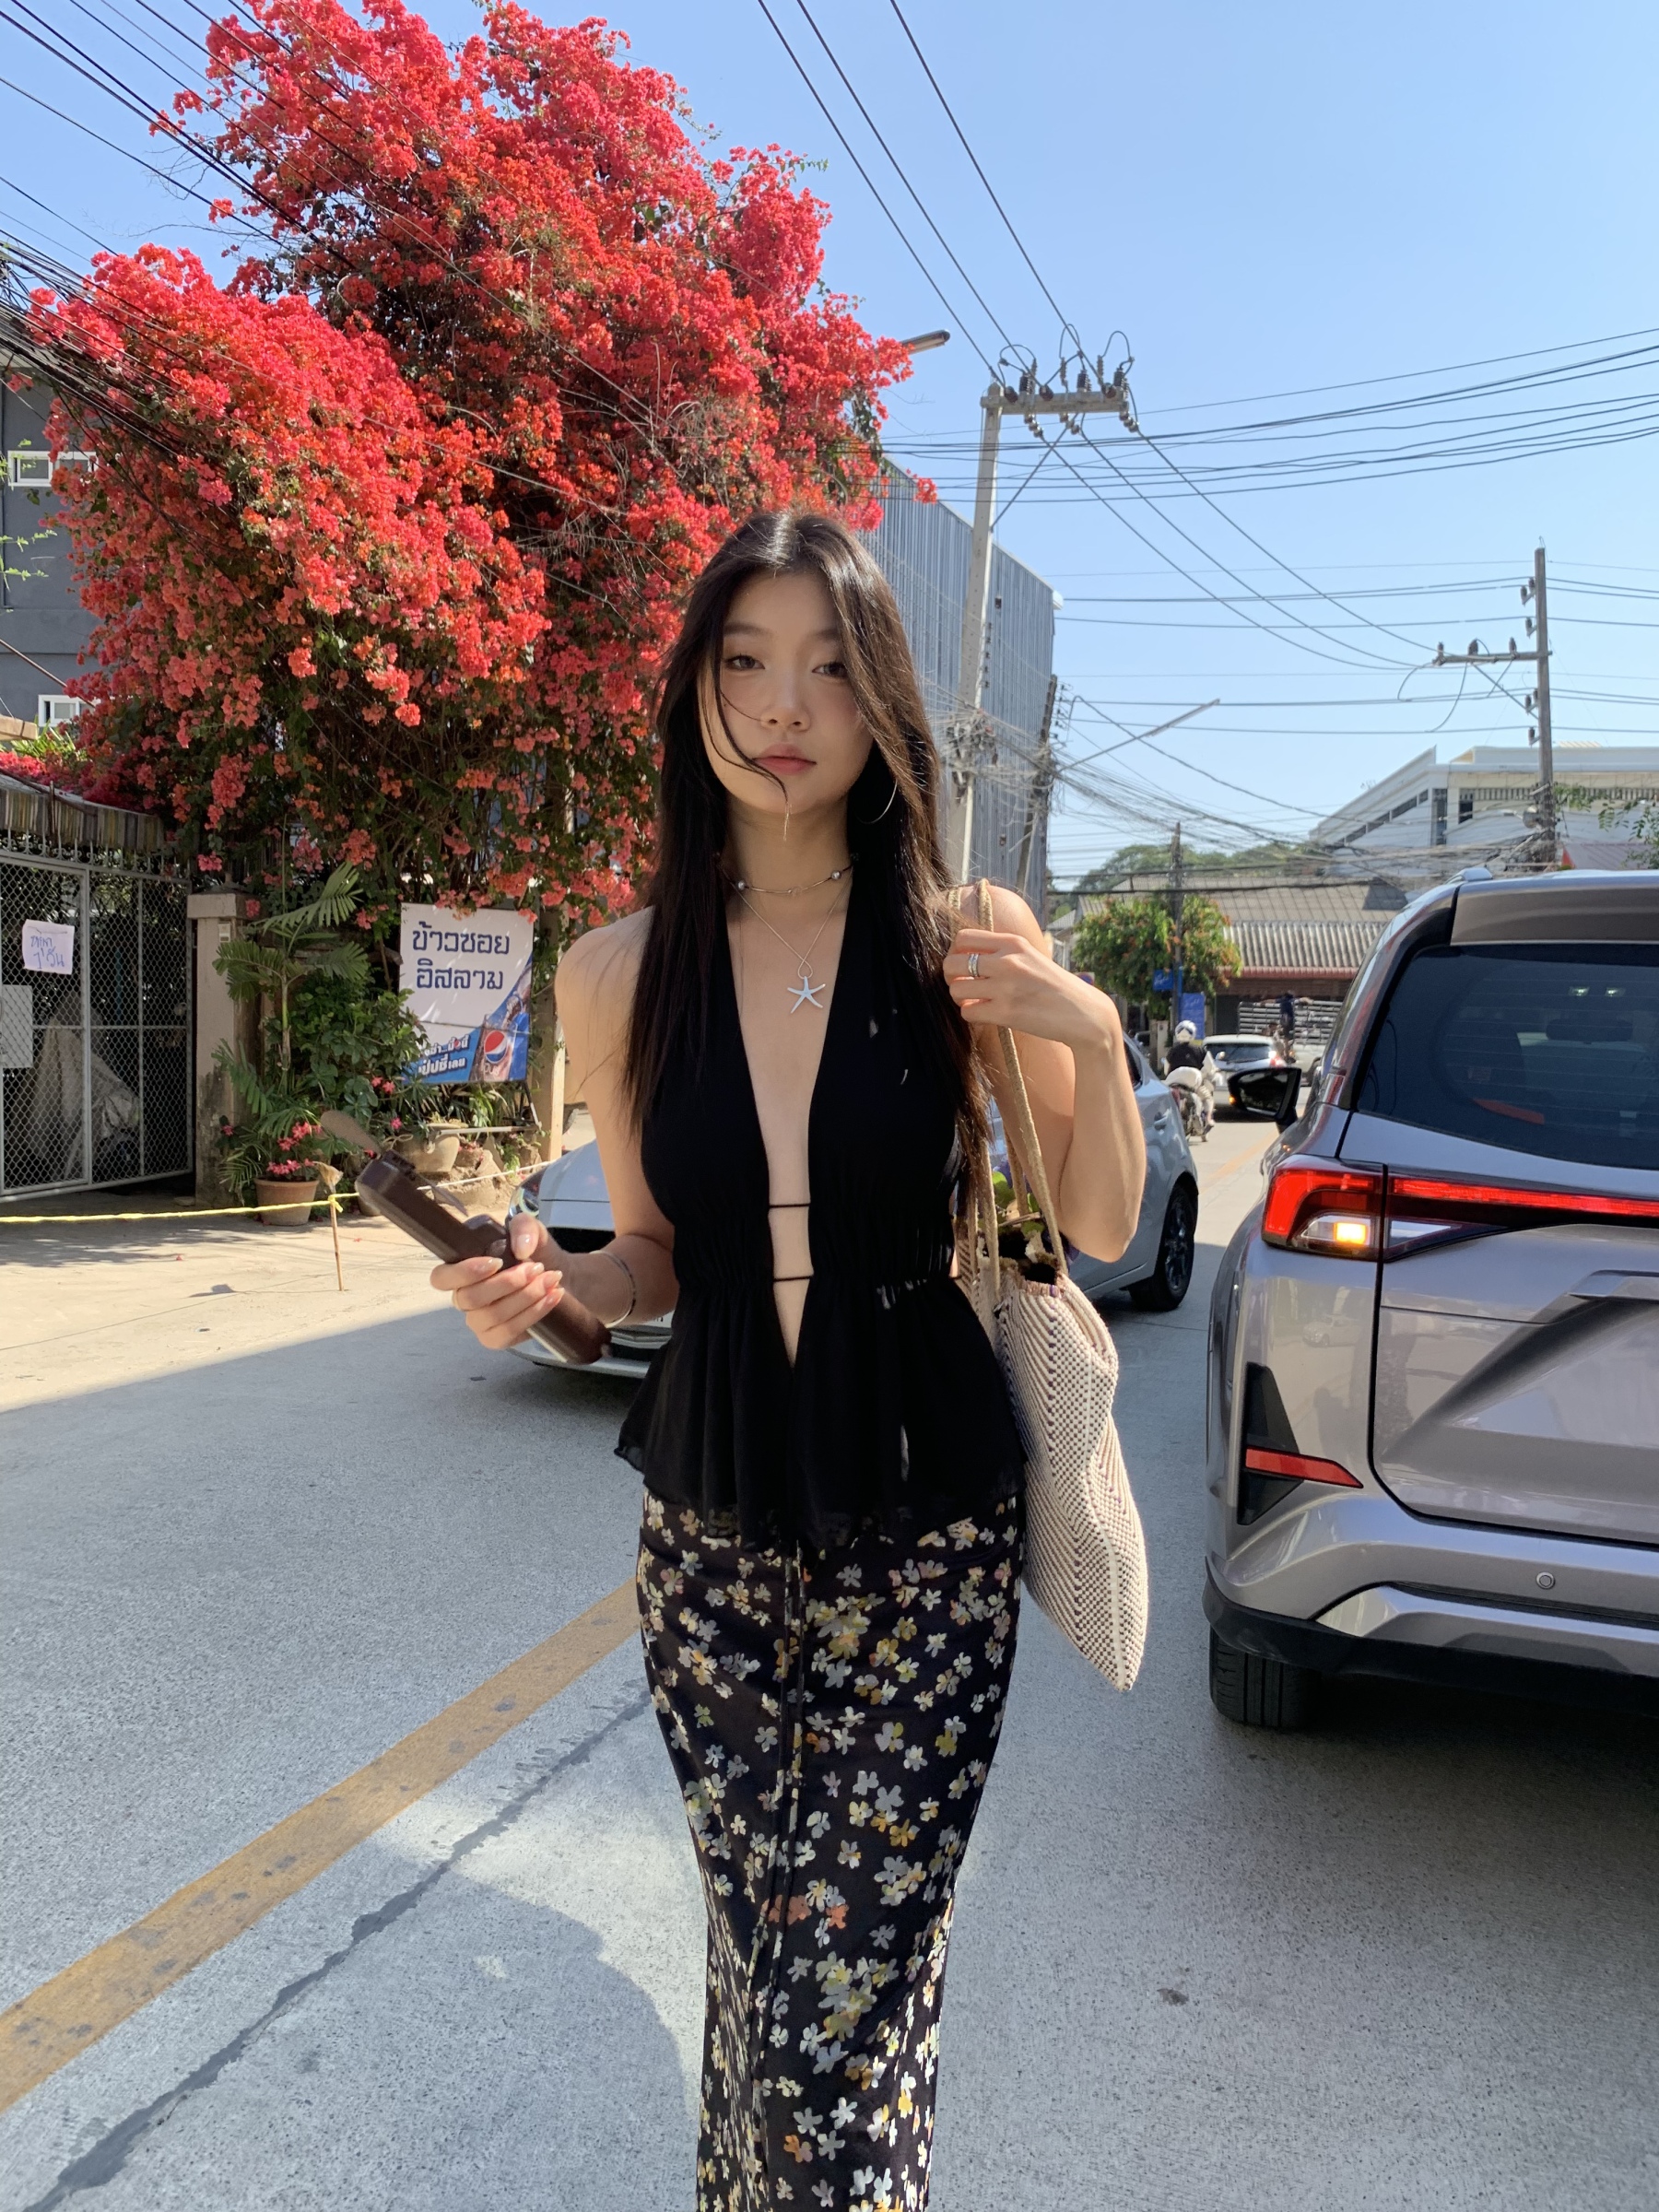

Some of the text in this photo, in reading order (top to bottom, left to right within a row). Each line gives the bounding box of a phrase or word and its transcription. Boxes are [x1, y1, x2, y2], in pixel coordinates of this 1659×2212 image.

[413, 921, 510, 955] ข้าวซอย
[417, 958, 503, 990] อิสลาม
